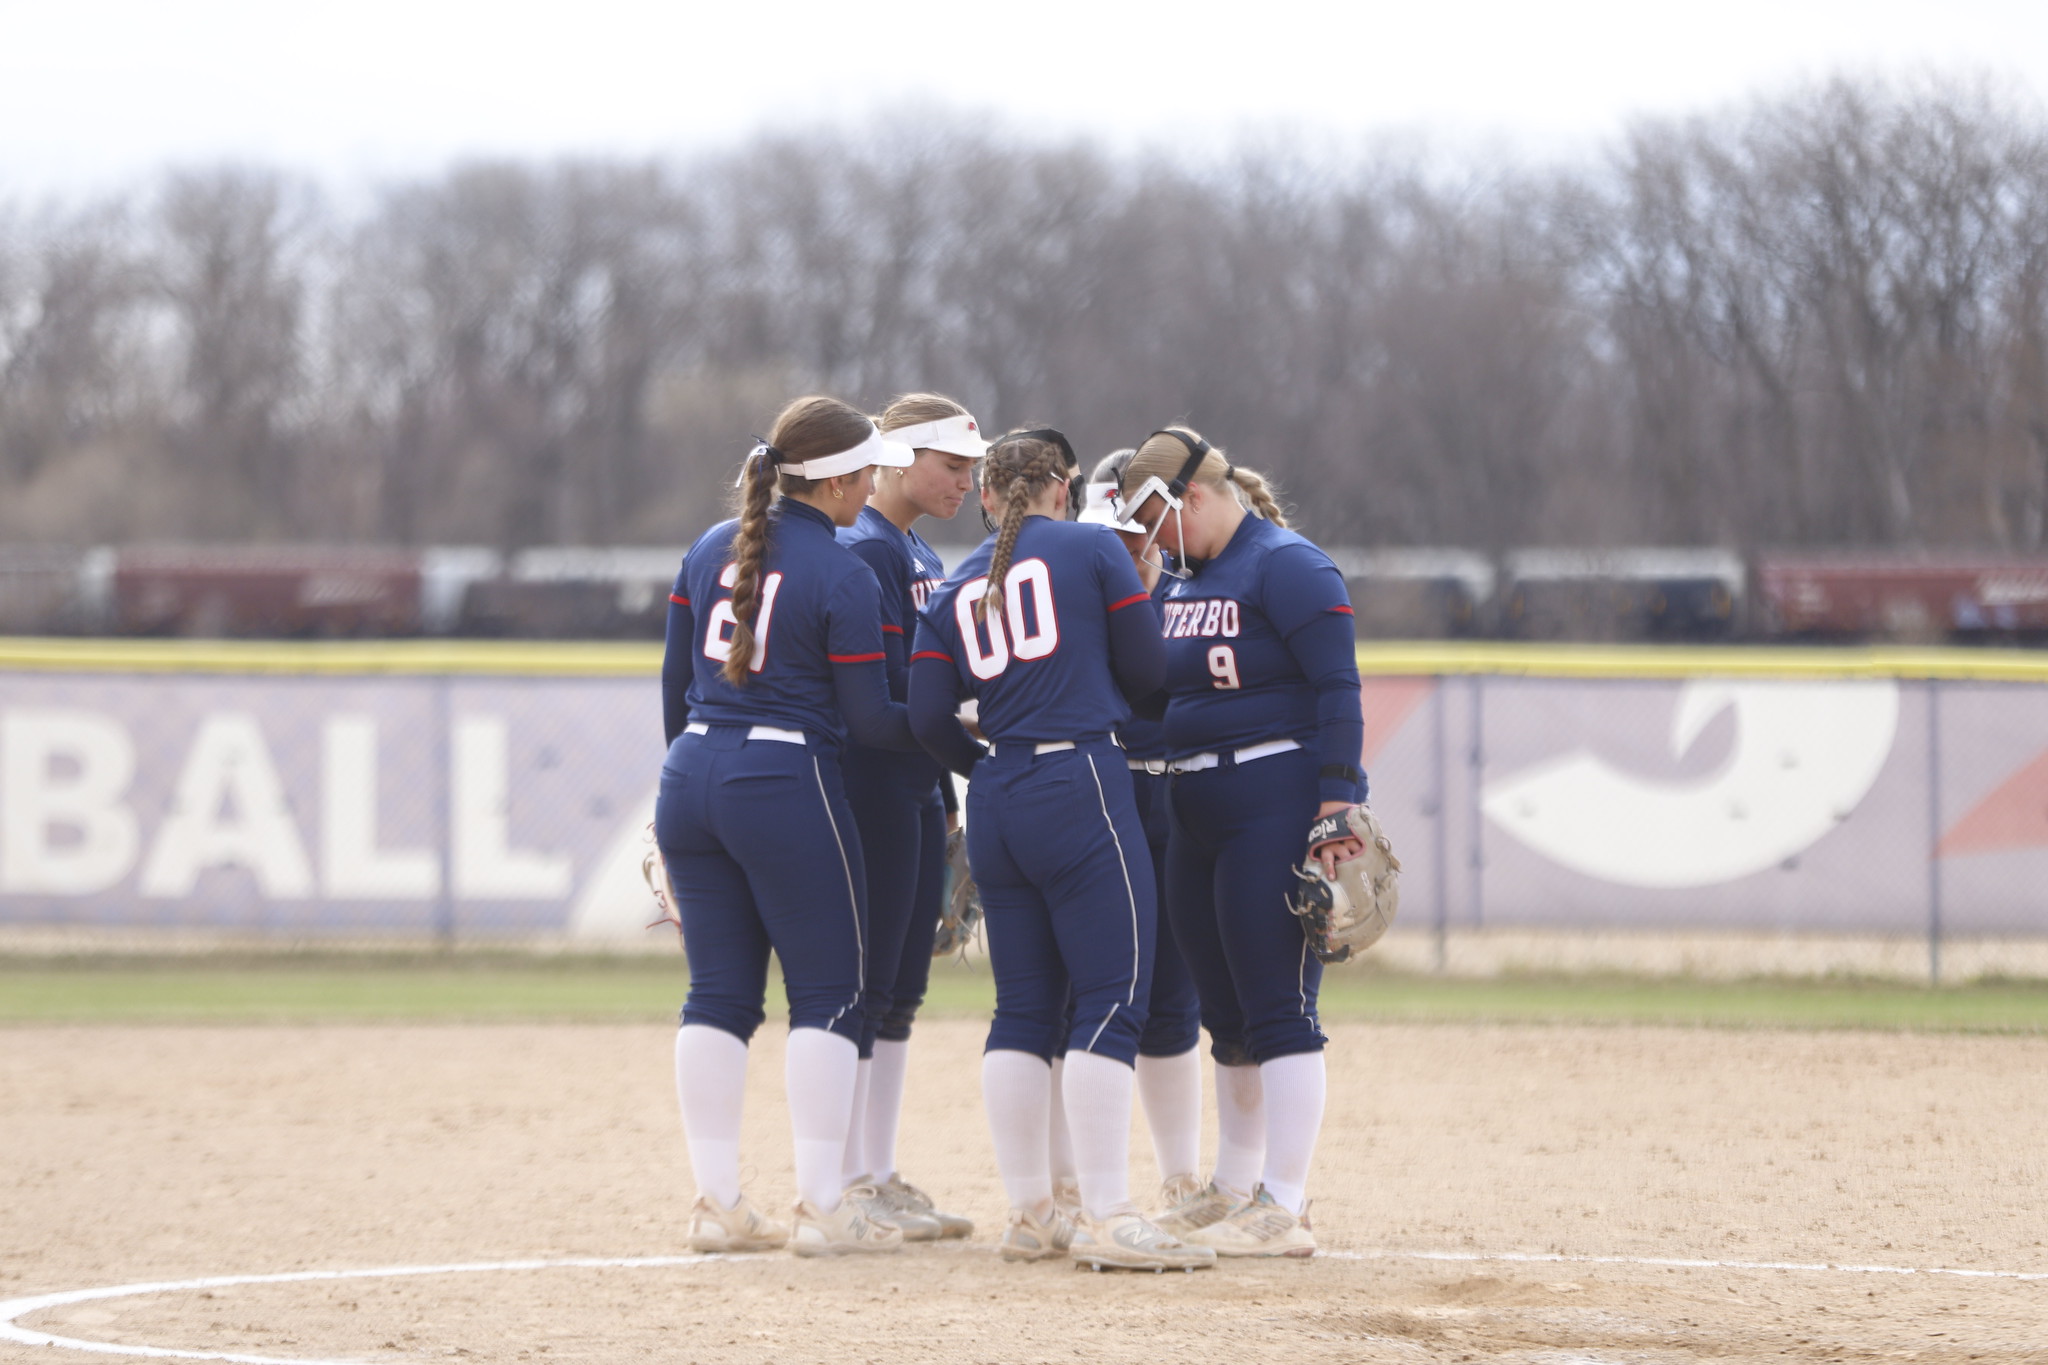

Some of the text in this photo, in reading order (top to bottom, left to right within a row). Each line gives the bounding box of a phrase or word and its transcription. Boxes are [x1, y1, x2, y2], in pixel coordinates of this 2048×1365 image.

[703, 559, 784, 674] 21
[955, 557, 1060, 682] 00
[1162, 599, 1240, 639] ITERBO
[1208, 644, 1241, 690] 9
[2, 708, 572, 898] BALL
